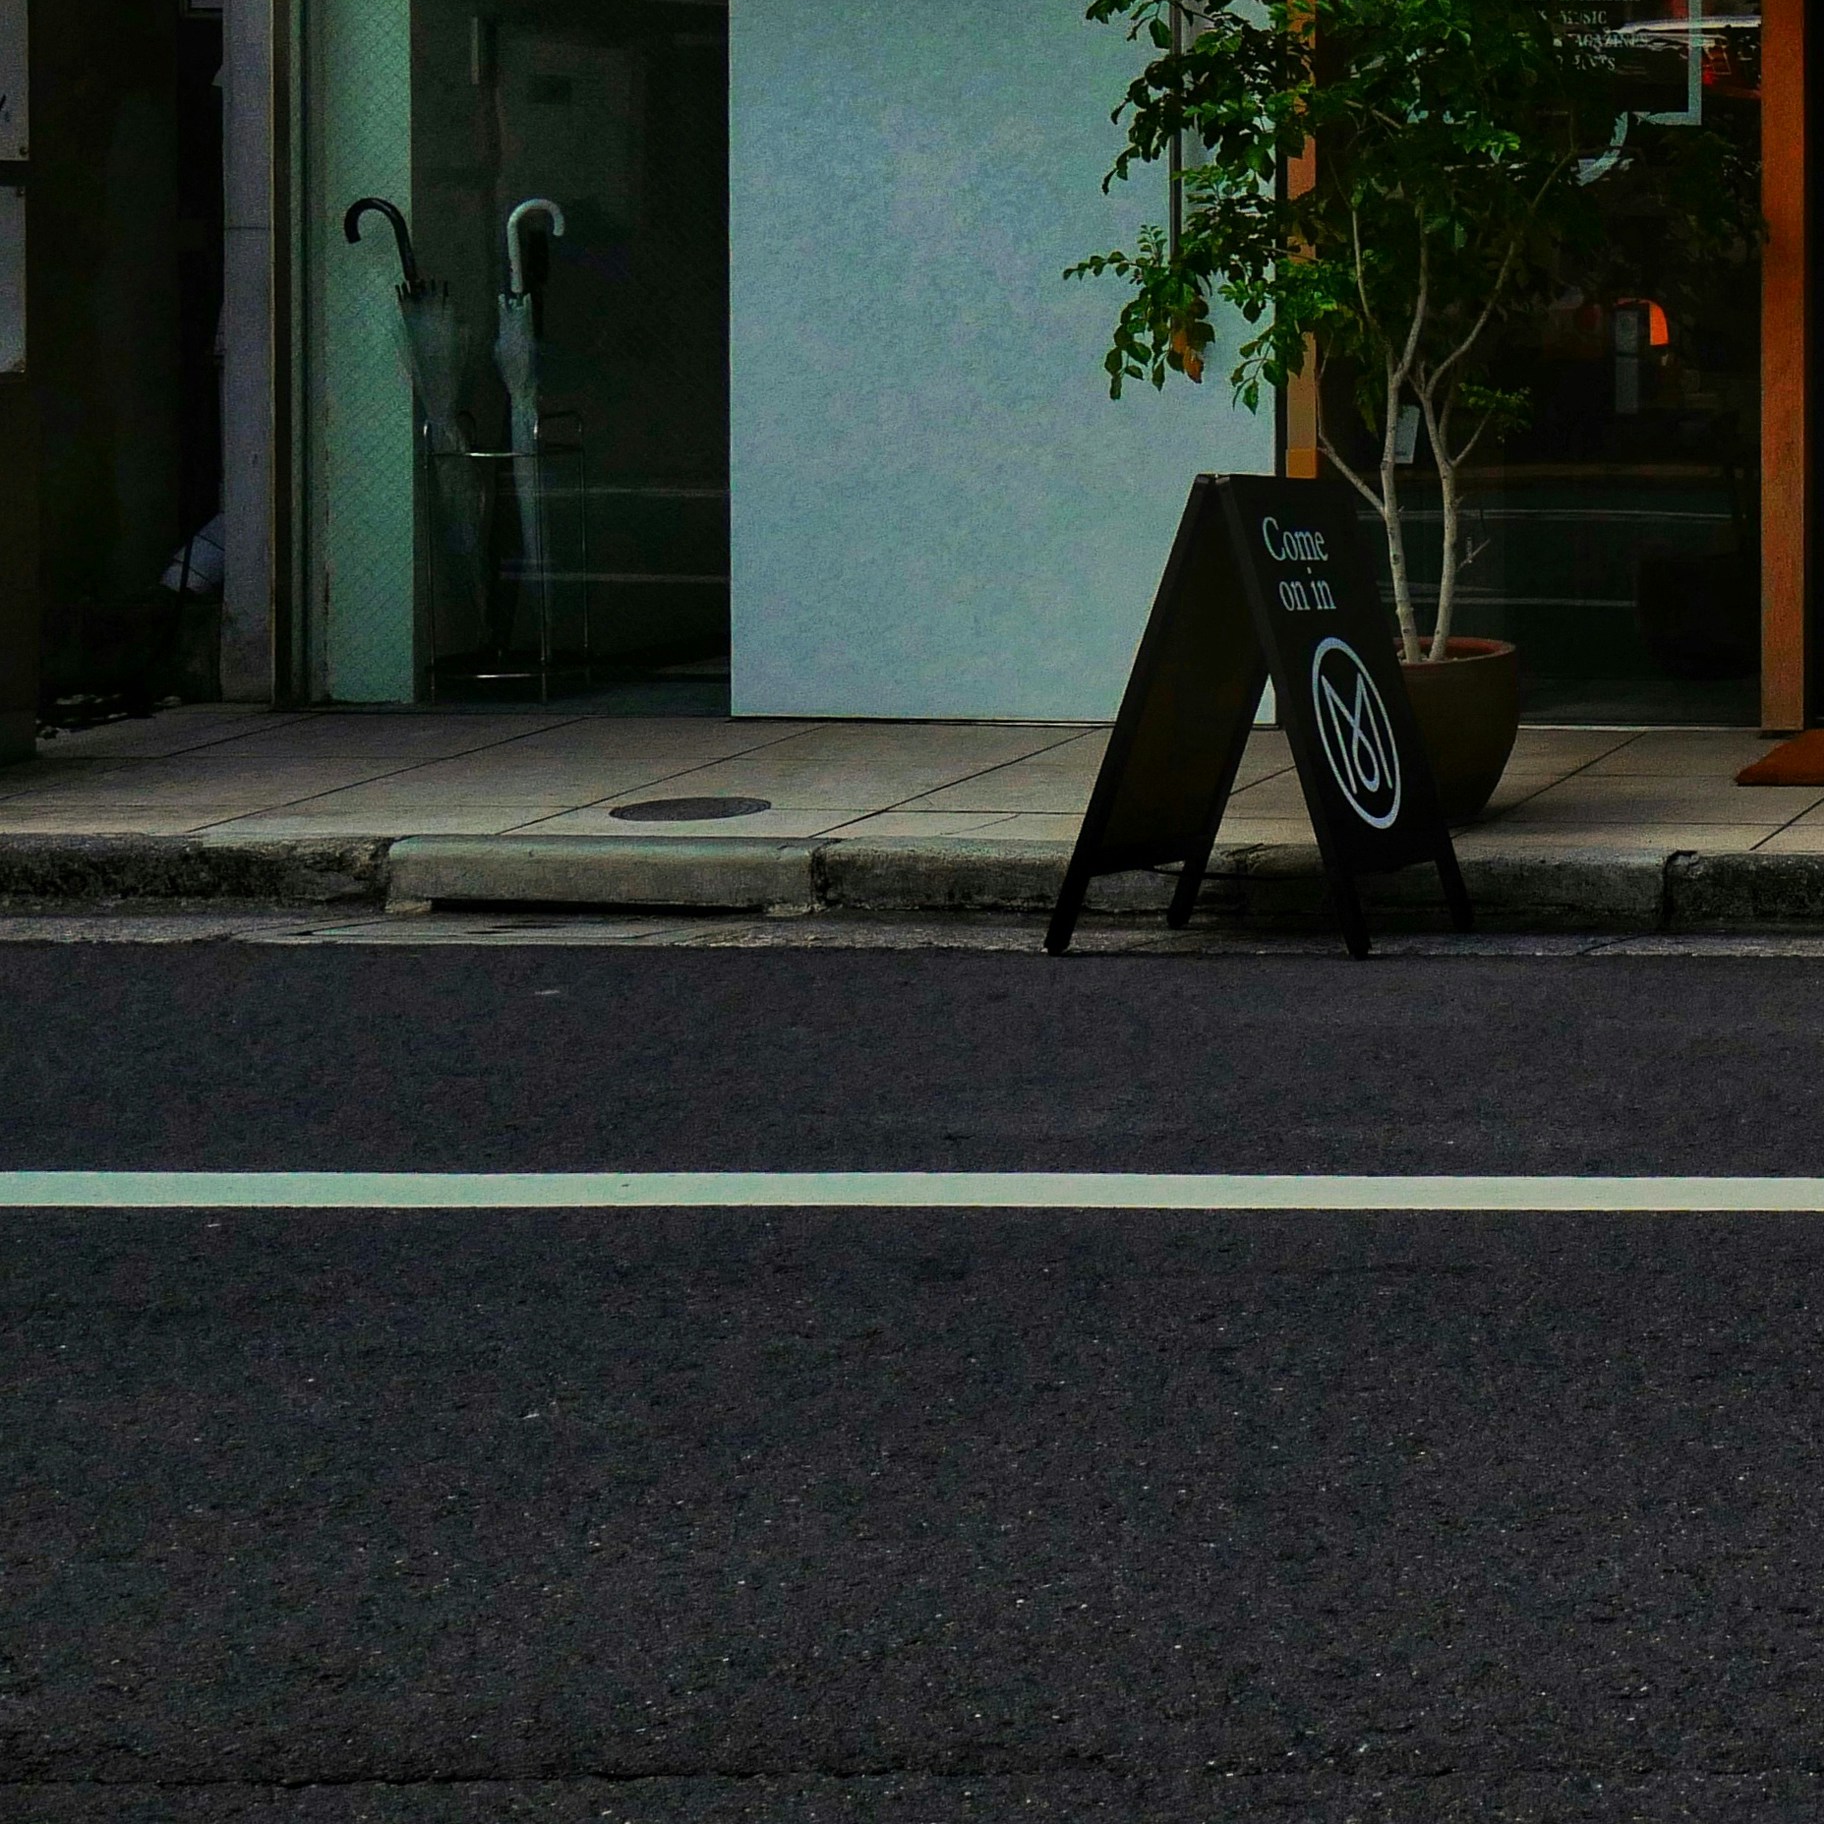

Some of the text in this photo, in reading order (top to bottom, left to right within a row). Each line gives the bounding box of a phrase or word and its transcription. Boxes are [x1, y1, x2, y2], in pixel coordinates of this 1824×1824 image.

[1262, 516, 1329, 562] Come
[1279, 566, 1337, 611] on in
